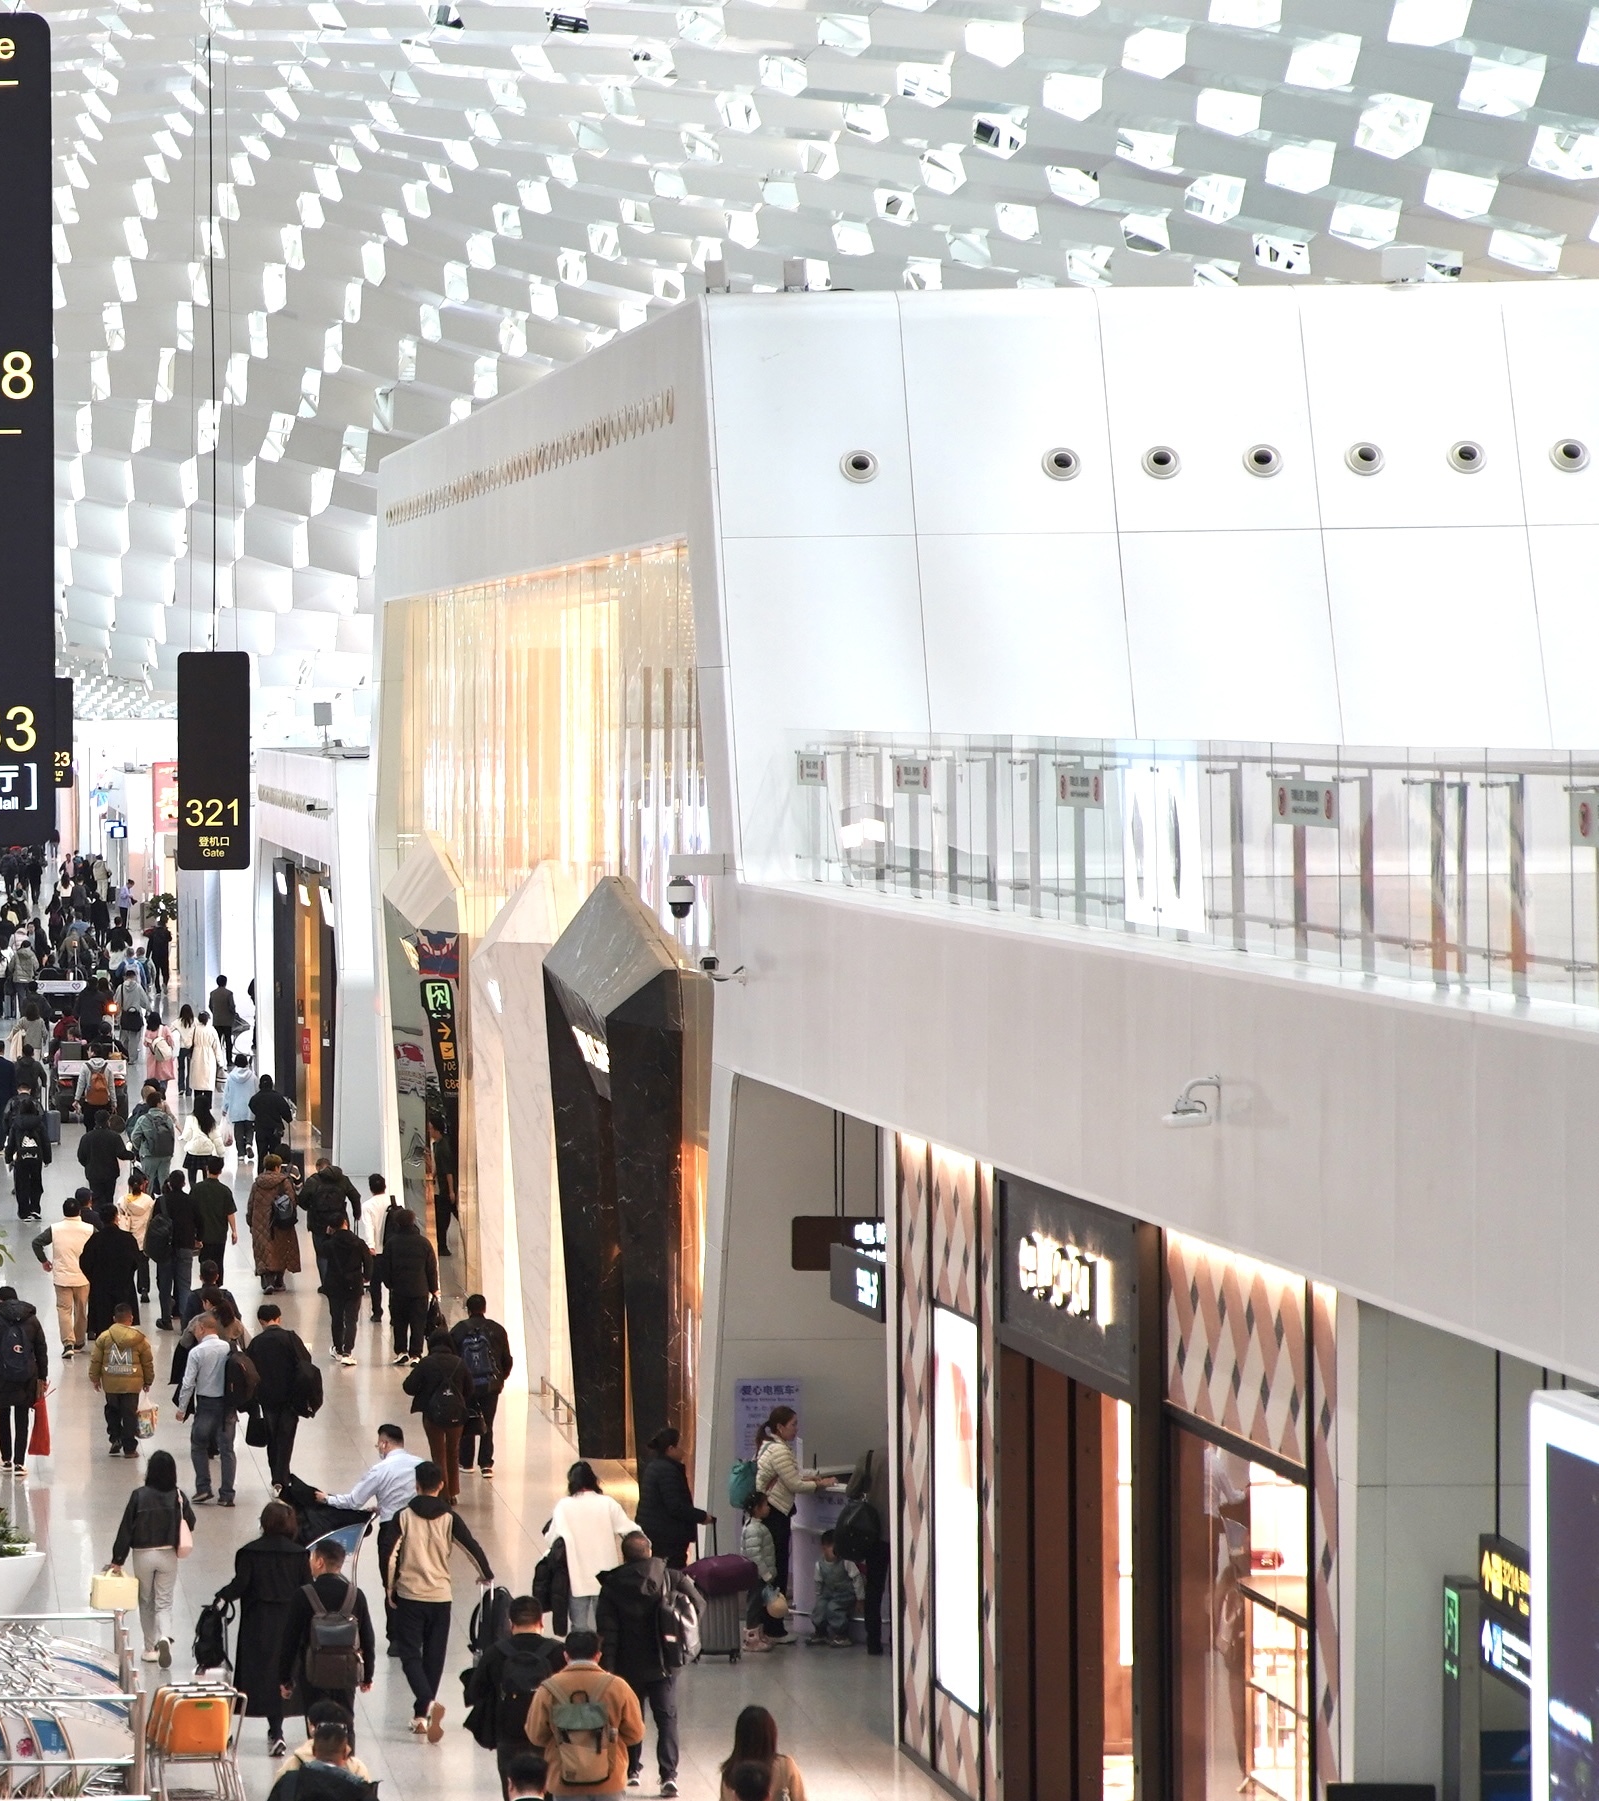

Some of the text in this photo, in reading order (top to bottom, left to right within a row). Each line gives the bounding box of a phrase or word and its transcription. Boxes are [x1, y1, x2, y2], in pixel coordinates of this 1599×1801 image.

[185, 798, 239, 827] 321
[198, 836, 230, 847] 登机口
[202, 847, 225, 858] Gate
